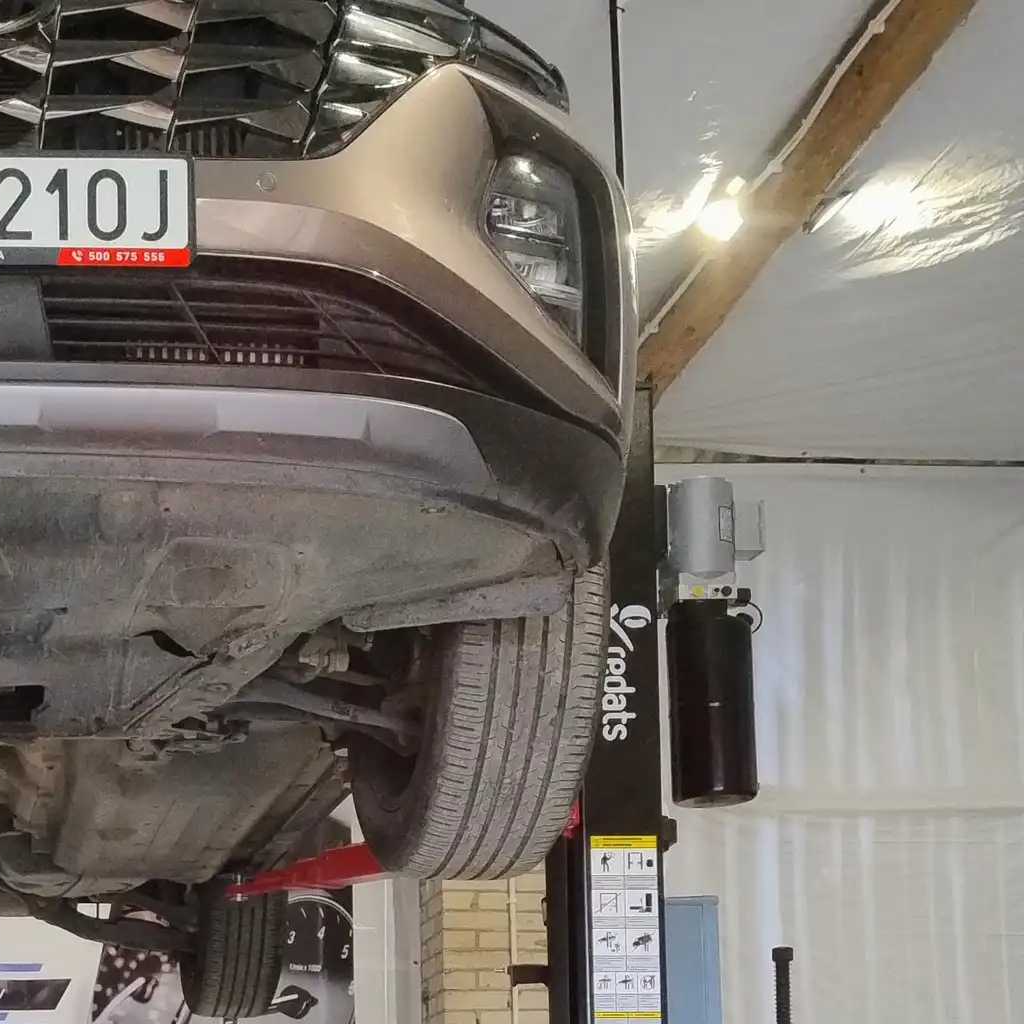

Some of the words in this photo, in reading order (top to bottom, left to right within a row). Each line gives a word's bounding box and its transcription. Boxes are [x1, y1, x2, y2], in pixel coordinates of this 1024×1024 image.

[88, 251, 110, 262] 500
[115, 251, 138, 262] 575
[601, 646, 638, 742] redats
